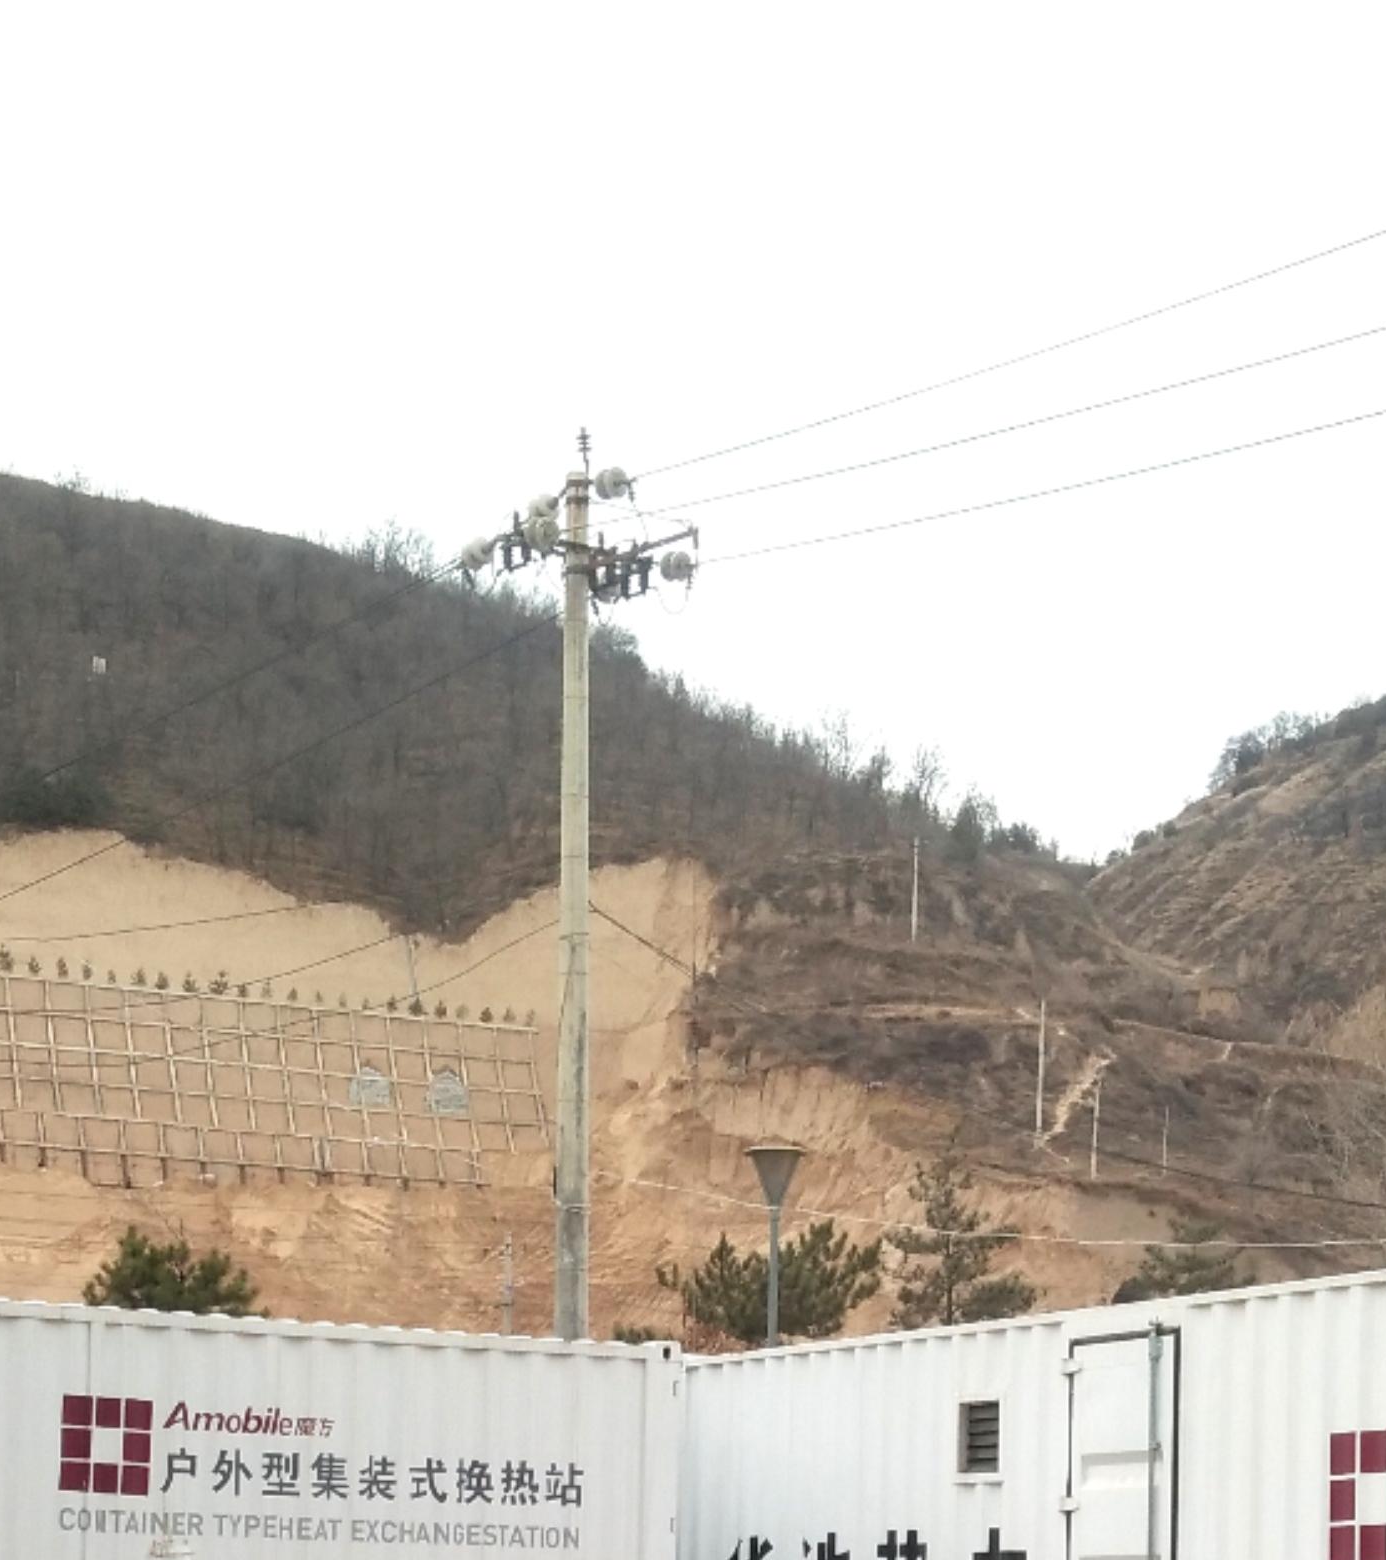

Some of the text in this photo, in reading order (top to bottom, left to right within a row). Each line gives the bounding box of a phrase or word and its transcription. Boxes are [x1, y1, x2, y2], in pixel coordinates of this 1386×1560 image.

[163, 1402, 293, 1436] Amobile
[160, 1448, 584, 1508] 户外型集装式换热站
[59, 1507, 203, 1537] CONTAINER
